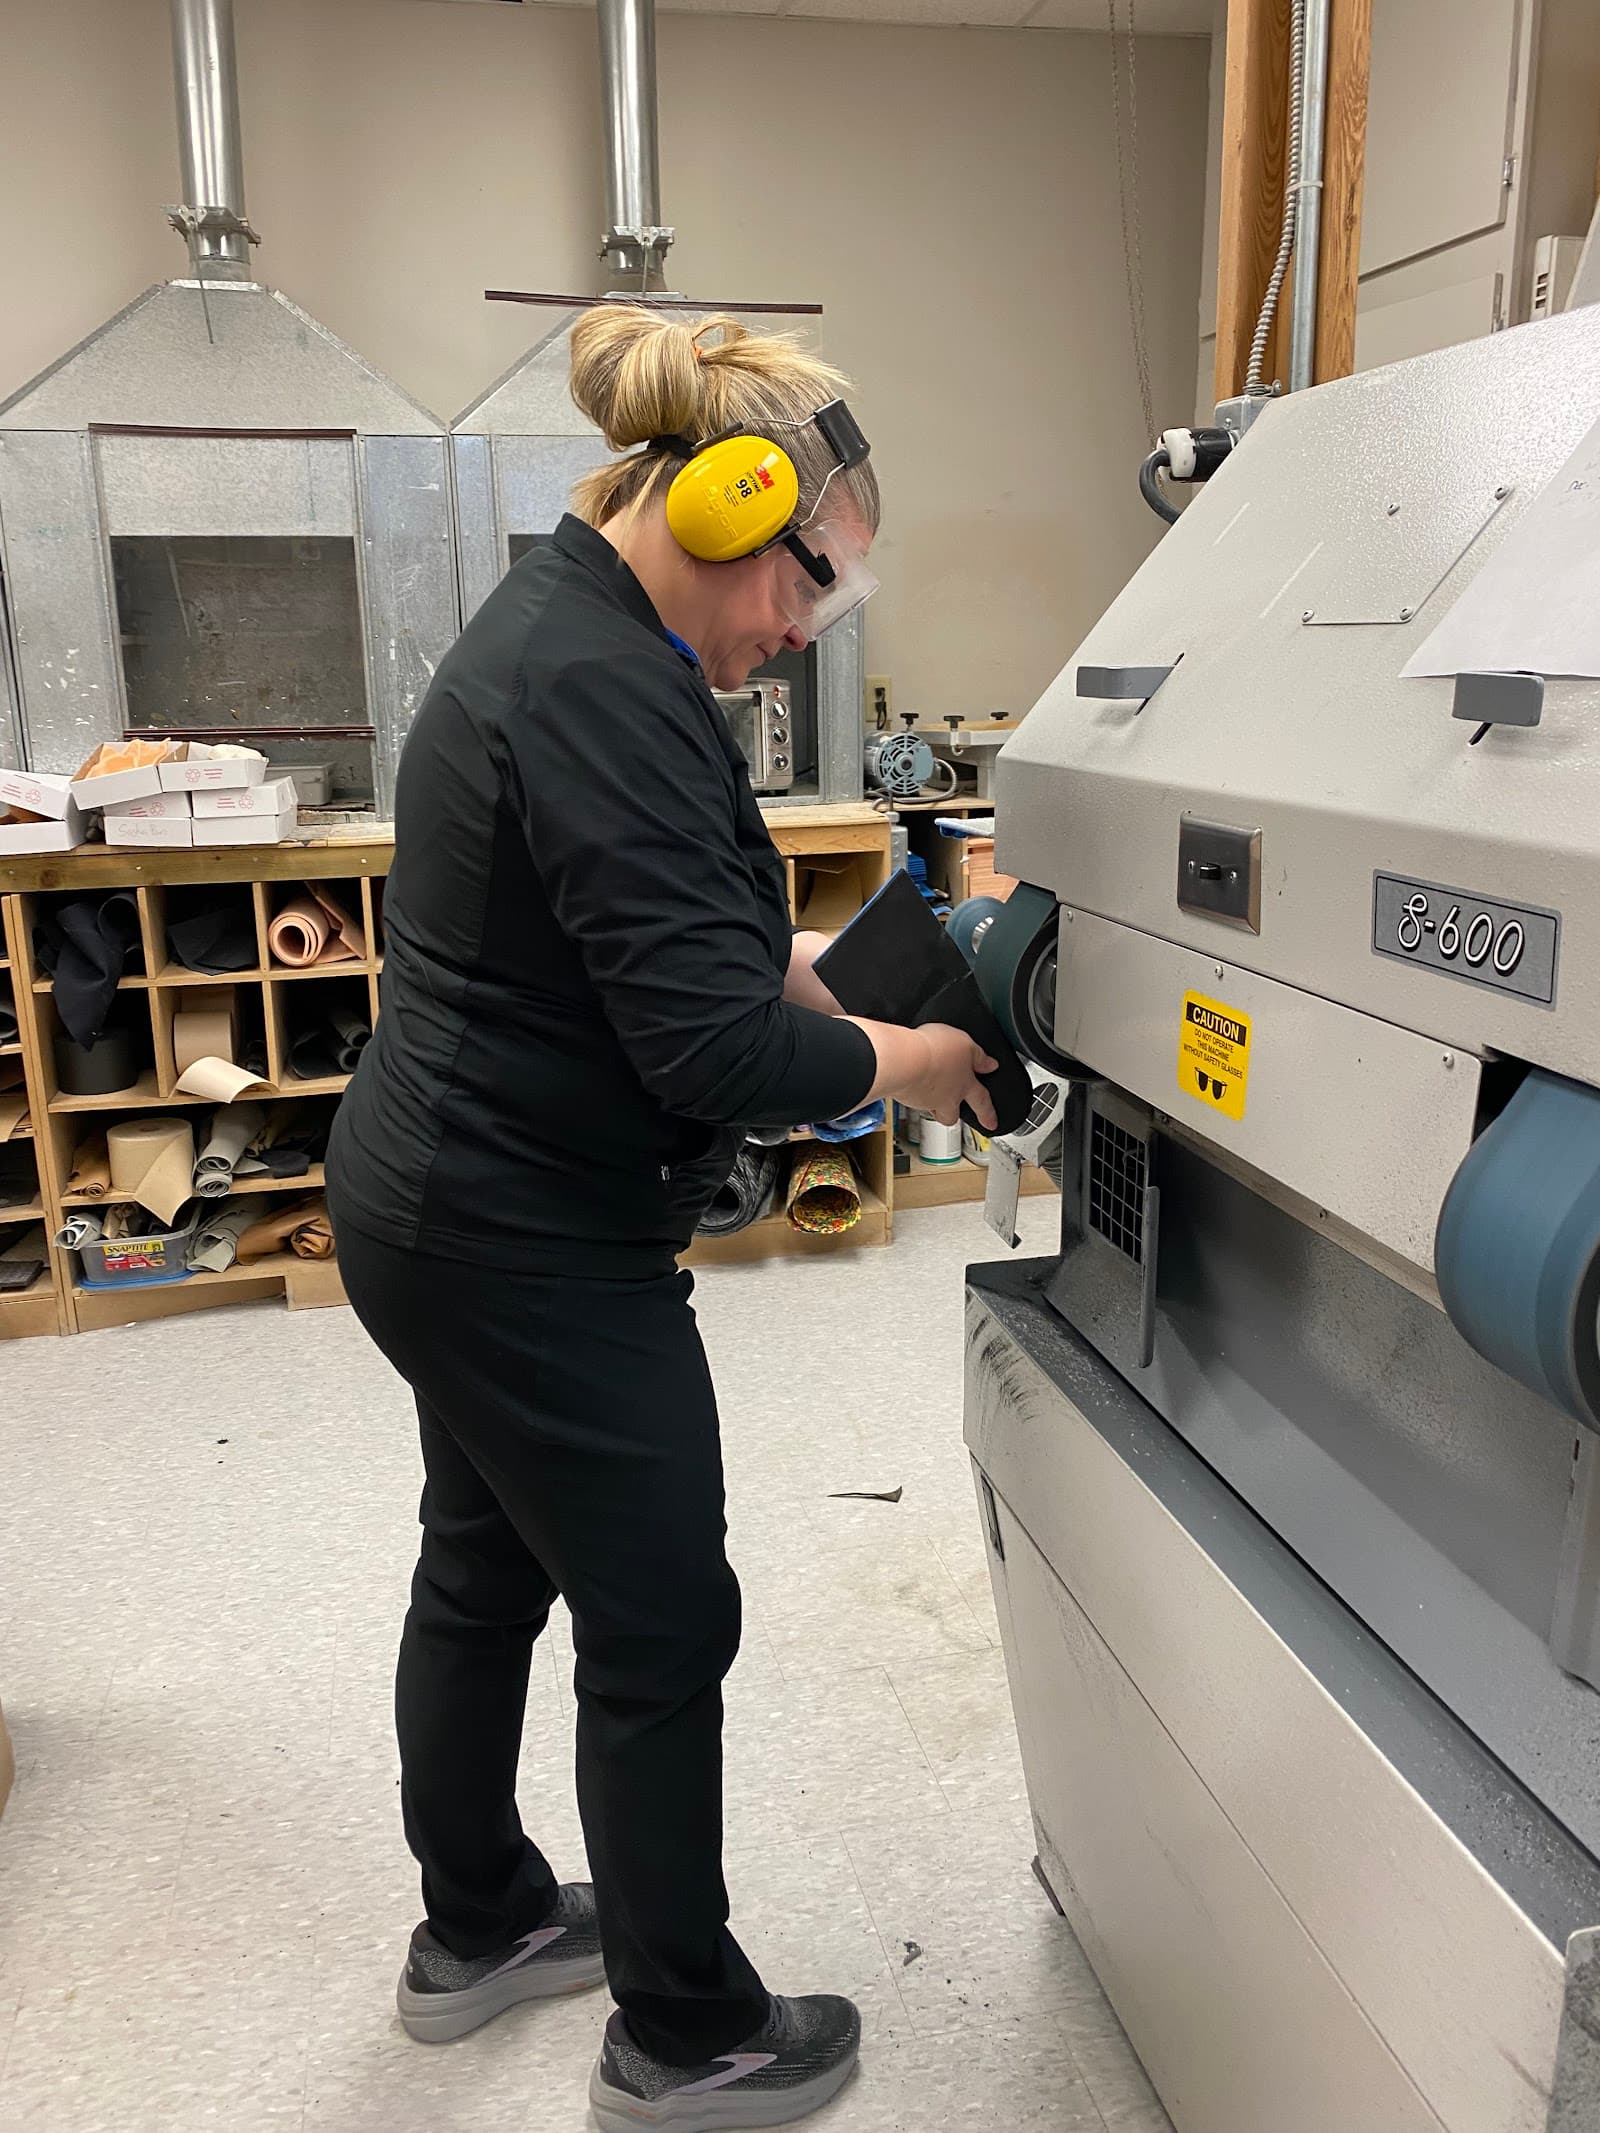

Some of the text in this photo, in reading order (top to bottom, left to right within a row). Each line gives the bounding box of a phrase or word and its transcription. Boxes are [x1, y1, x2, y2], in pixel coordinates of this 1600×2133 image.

[735, 478, 753, 498] 98
[754, 464, 775, 490] 3M
[1193, 1007, 1239, 1041] CAUTION
[1194, 1028, 1234, 1053] DO NOT OPERATE
[1197, 1039, 1230, 1062] THIS MACHINE
[1183, 1043, 1243, 1079] WITHOUT SAFETY GLASSES
